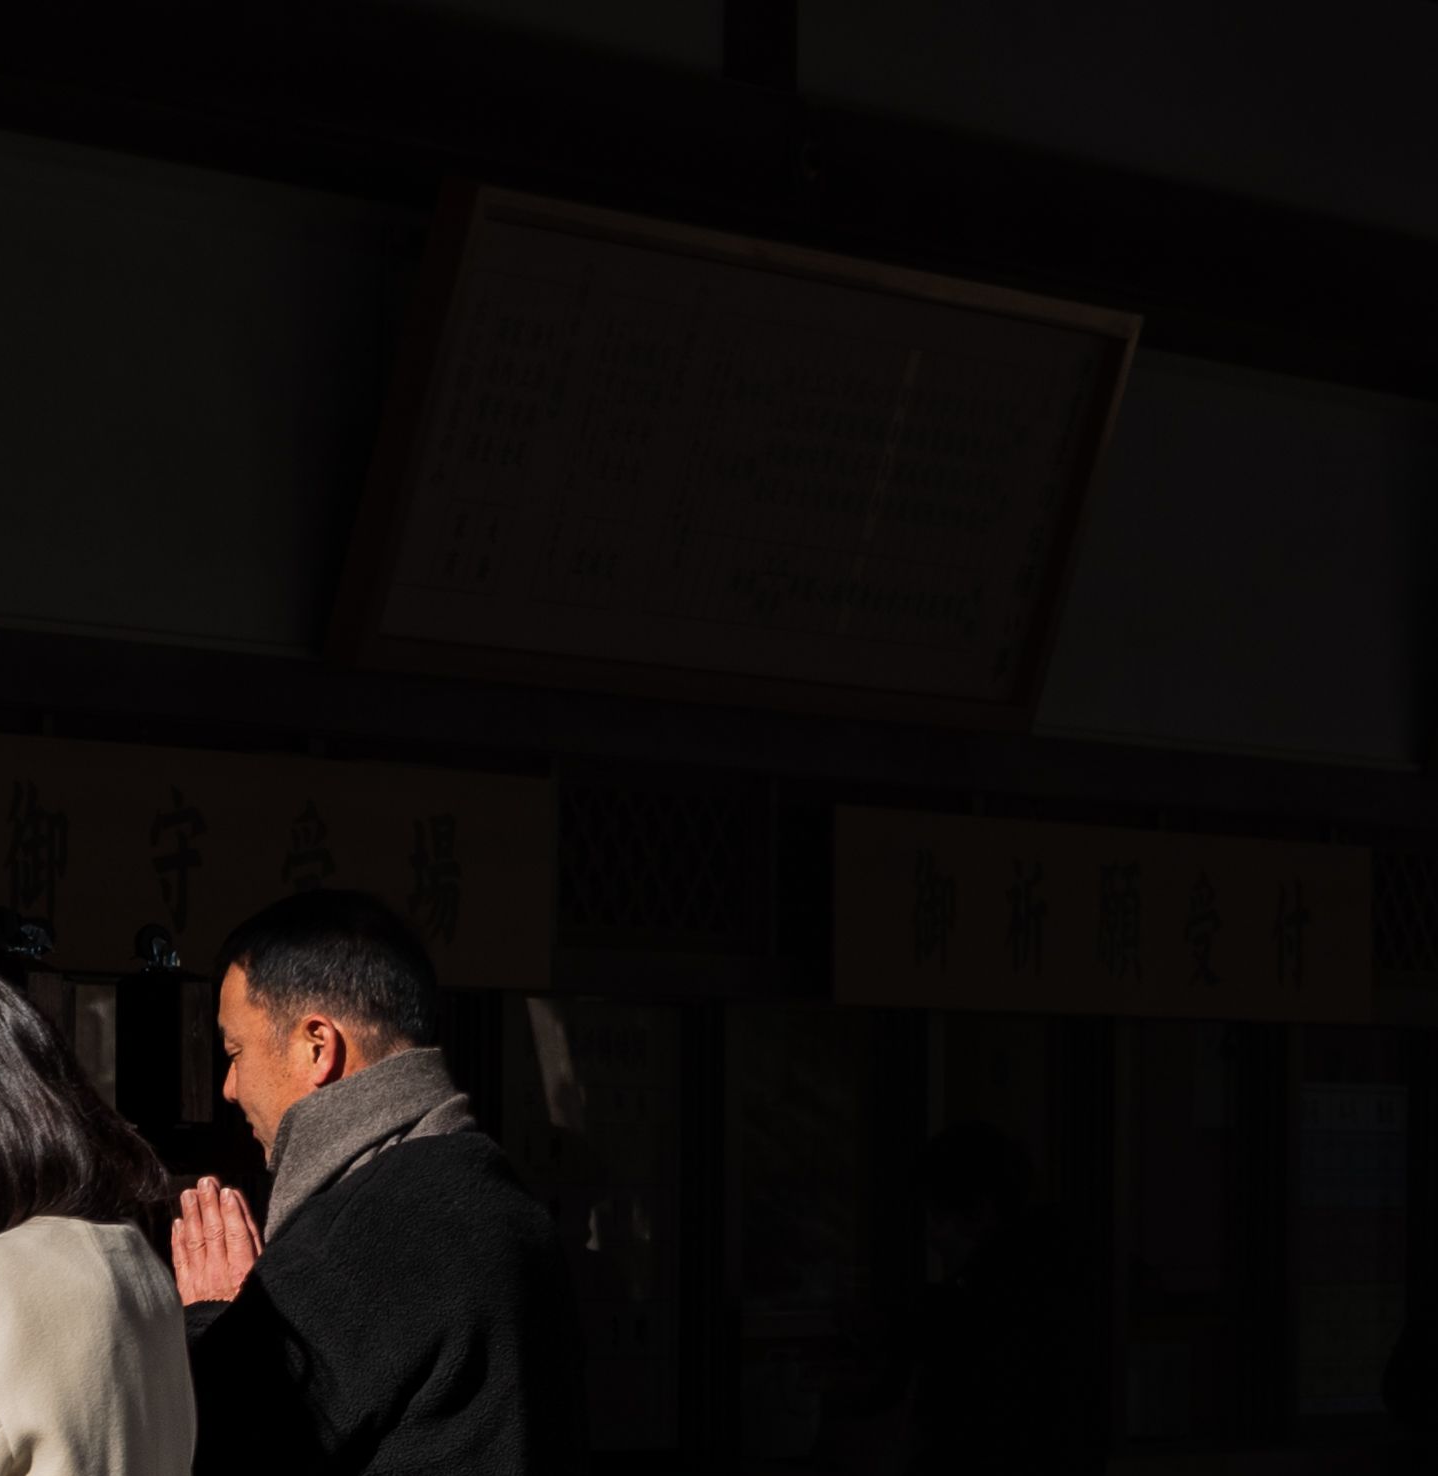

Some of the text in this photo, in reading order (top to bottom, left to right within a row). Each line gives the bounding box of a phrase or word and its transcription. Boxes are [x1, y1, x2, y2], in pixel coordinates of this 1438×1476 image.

[3, 779, 460, 944] 御守受場
[912, 847, 1310, 991] 御祈願受付
